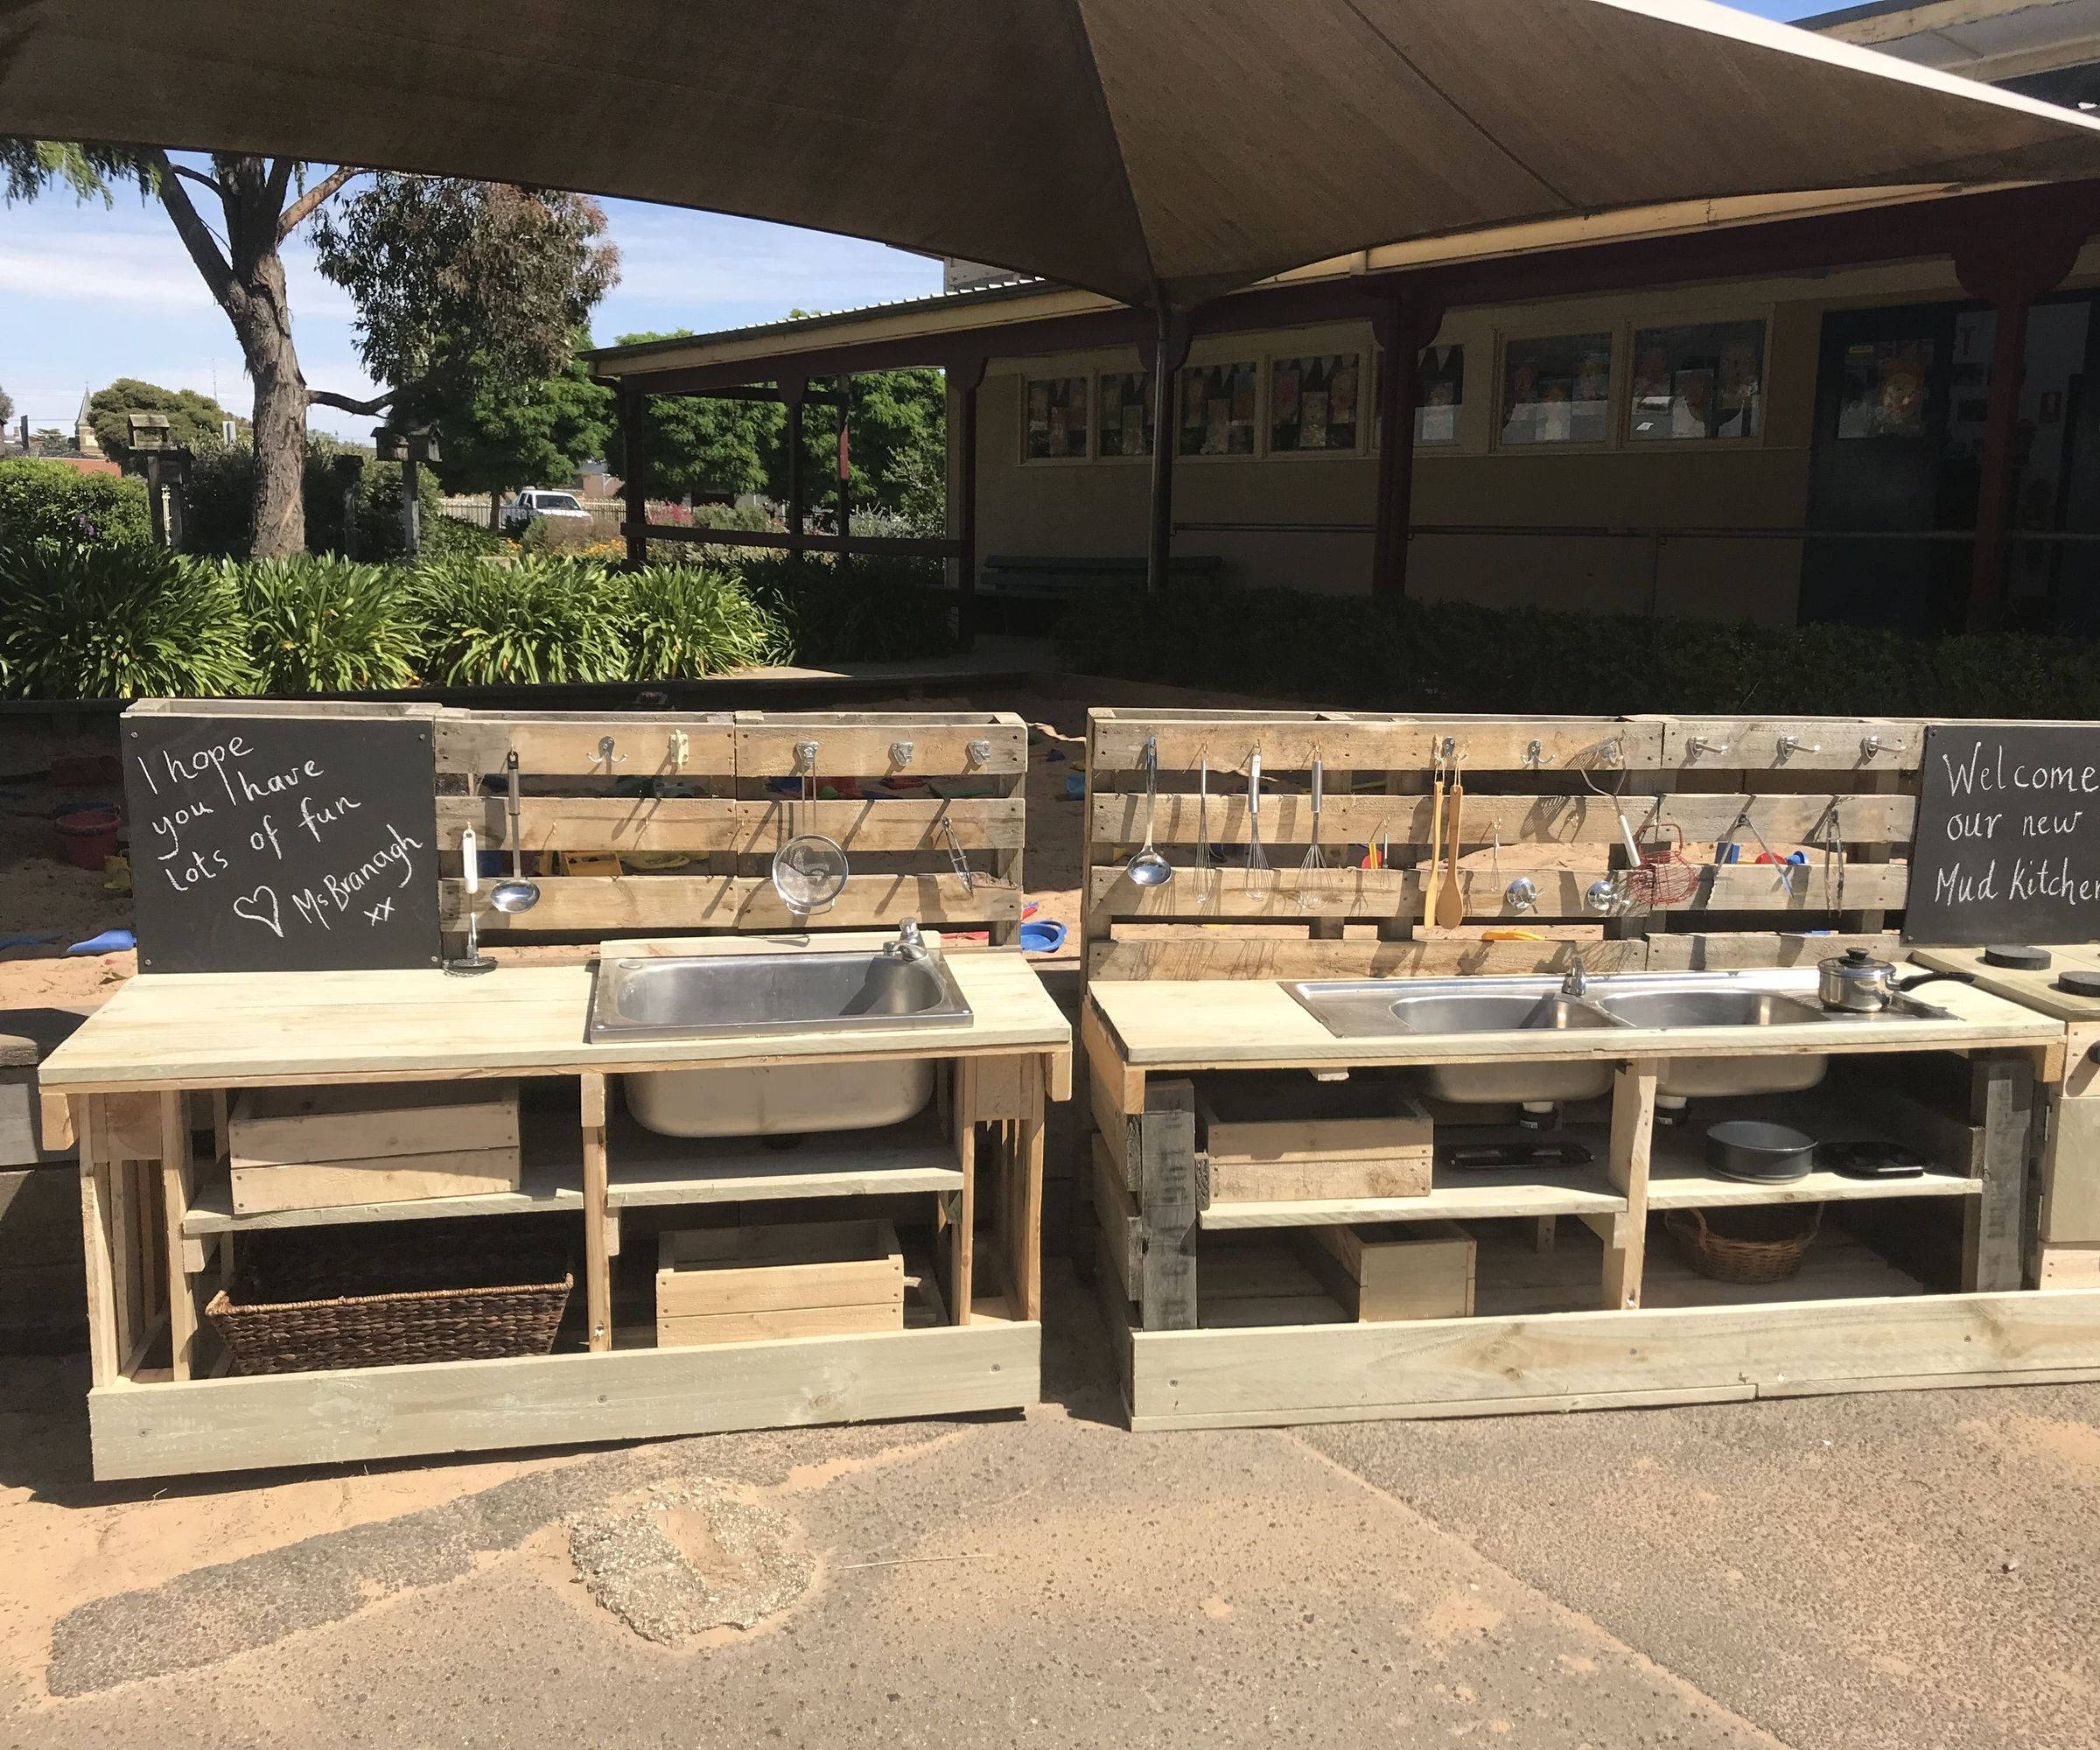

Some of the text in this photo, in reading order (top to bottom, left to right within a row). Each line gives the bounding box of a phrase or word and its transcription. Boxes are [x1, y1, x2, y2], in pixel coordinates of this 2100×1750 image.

[137, 737, 255, 806] I hope
[1942, 741, 2100, 797] Welcome
[152, 760, 325, 861] you have
[1947, 810, 2083, 841] our new
[165, 796, 362, 892] lots of fun
[1934, 858, 1998, 906] Mud
